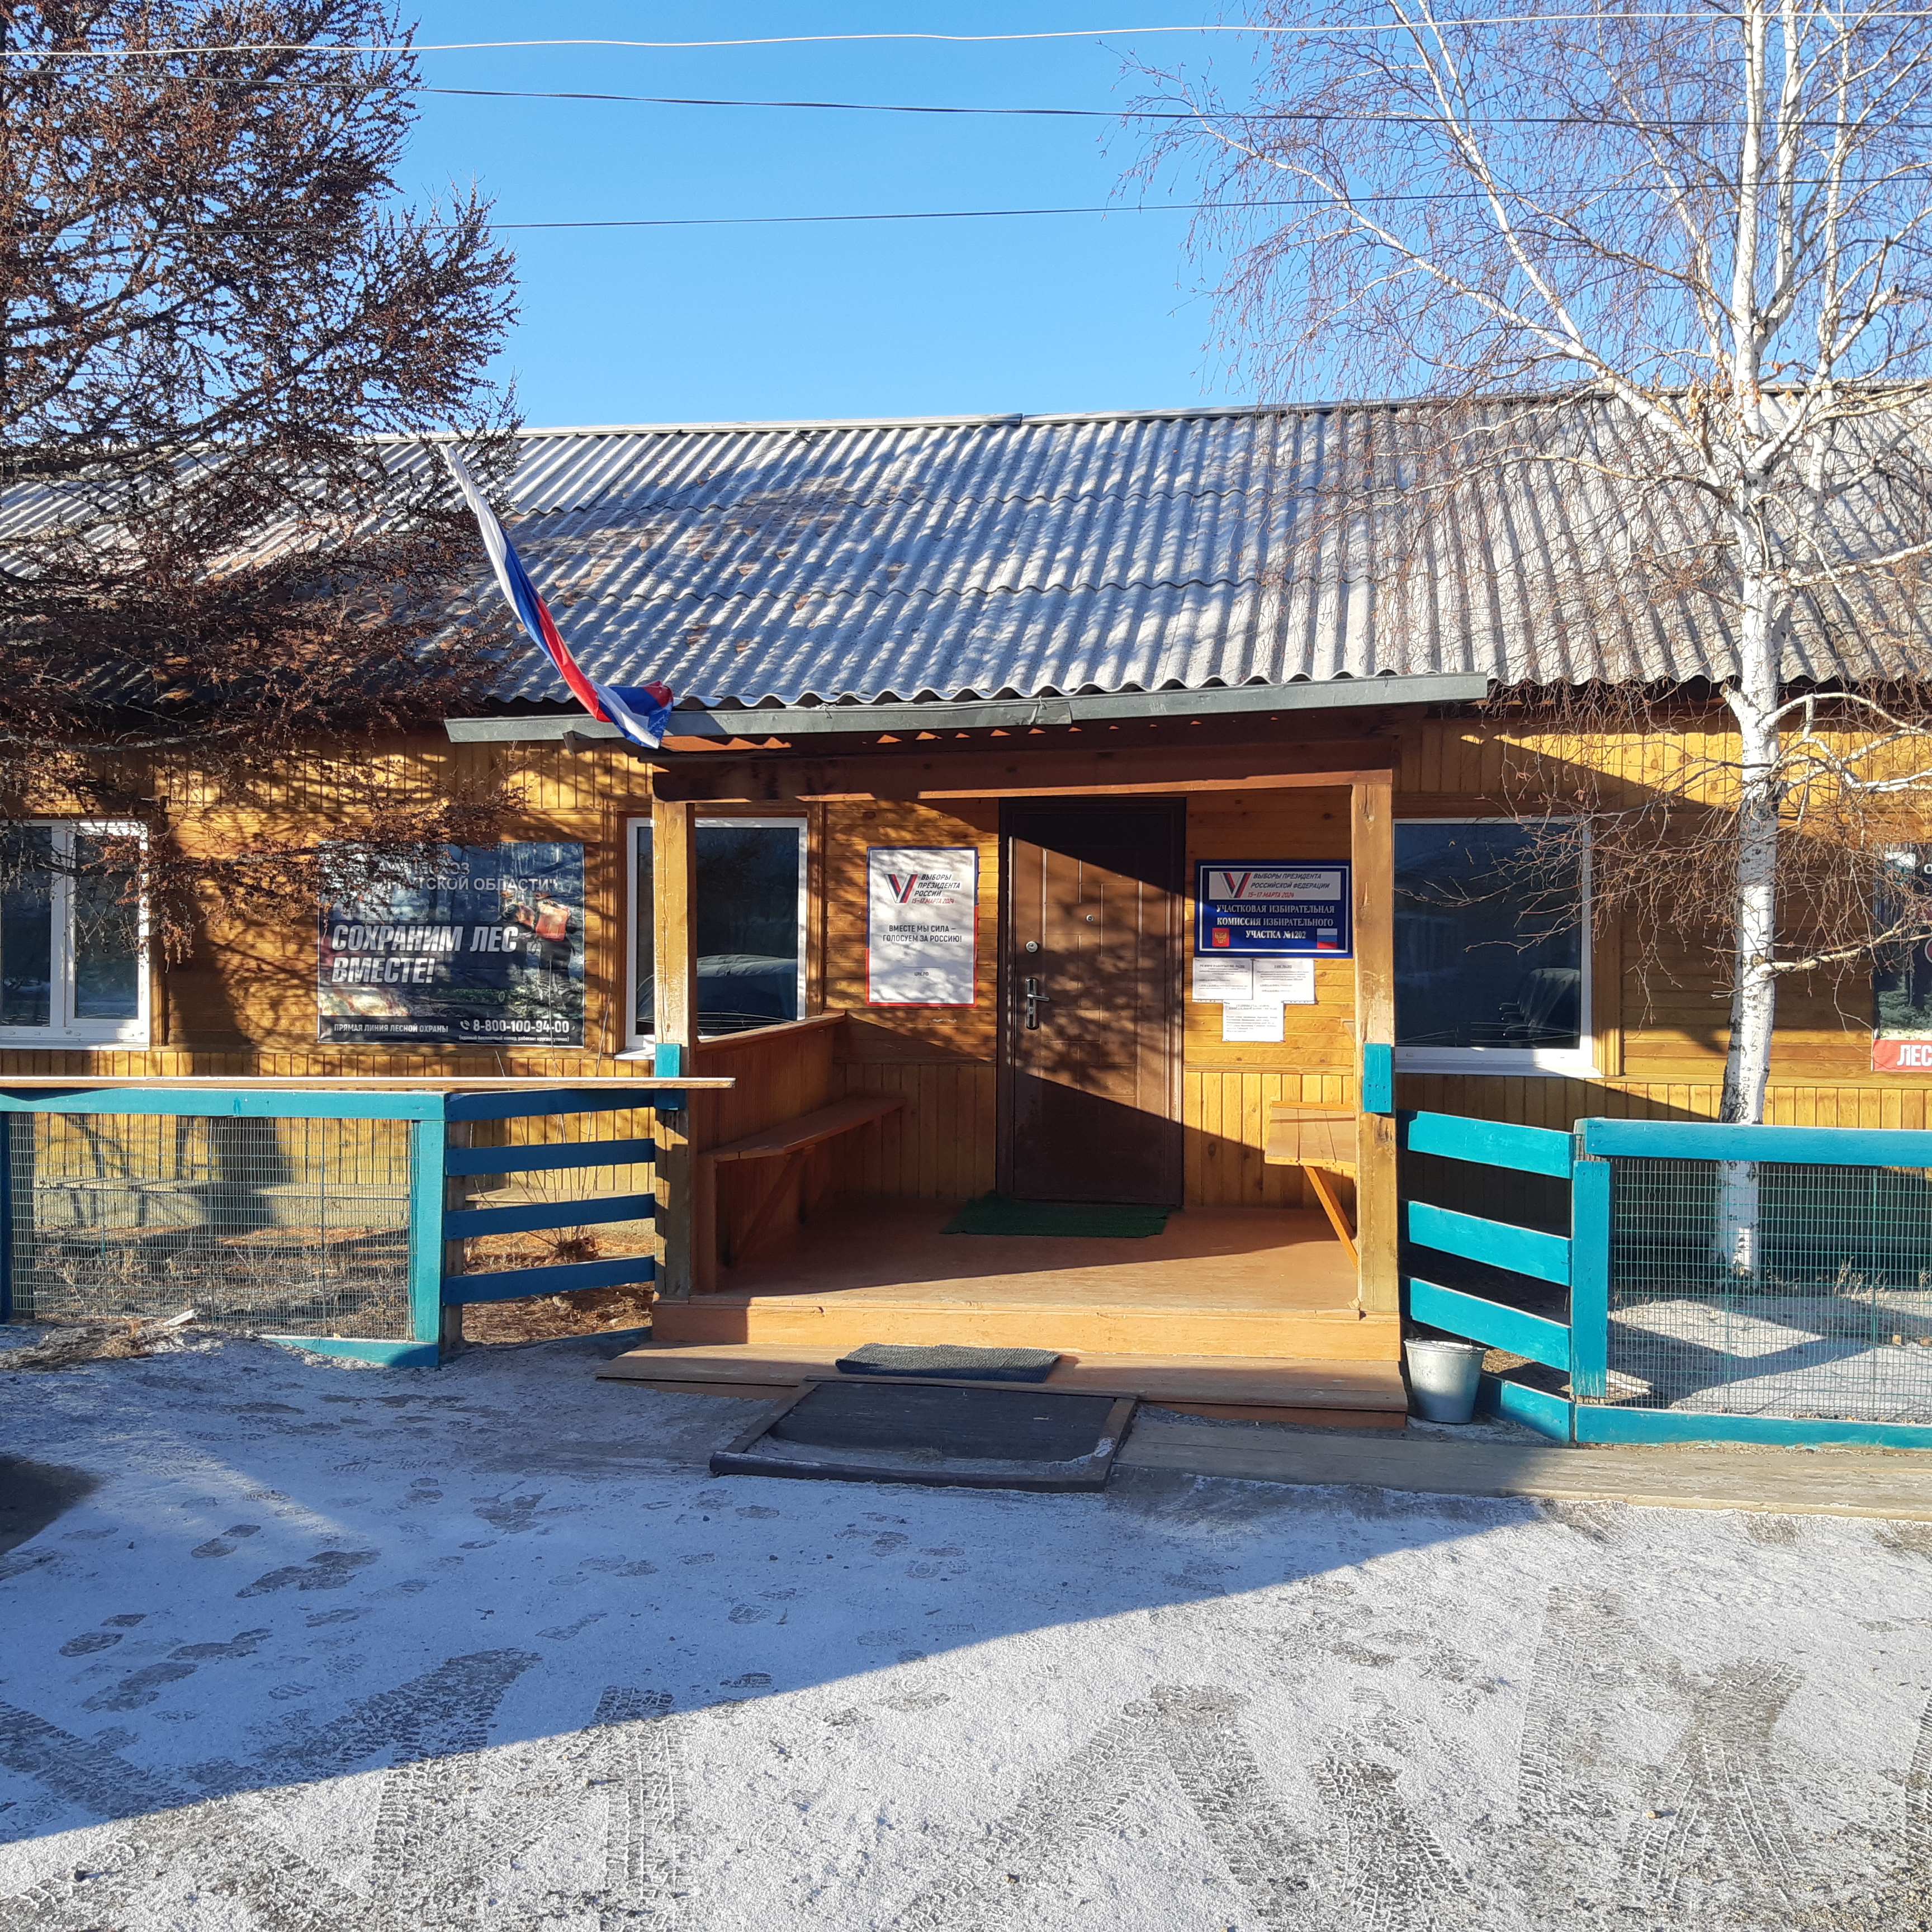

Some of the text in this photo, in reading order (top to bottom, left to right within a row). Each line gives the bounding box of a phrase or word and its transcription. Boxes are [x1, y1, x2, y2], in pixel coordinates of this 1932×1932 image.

[1216, 905, 1335, 913] УЧАСТКОВАЯ ИЗБИРАТЕЛЬНАЯ
[1217, 917, 1334, 926] КОМИССИЯ ИЗБИРАТЕЛЬНОГО
[332, 925, 518, 953] СОХРАНИМ ЛЕС
[1246, 930, 1306, 939] УЧАСТКА №1202
[332, 956, 435, 983] ВМЕСТЕ!
[334, 1024, 362, 1032] ПРЯМАЯ
[390, 1023, 418, 1033] ЛЕСНОЙ
[419, 1025, 449, 1033] ОХРАНЫ
[473, 1019, 569, 1033] 8-800-100-94-00
